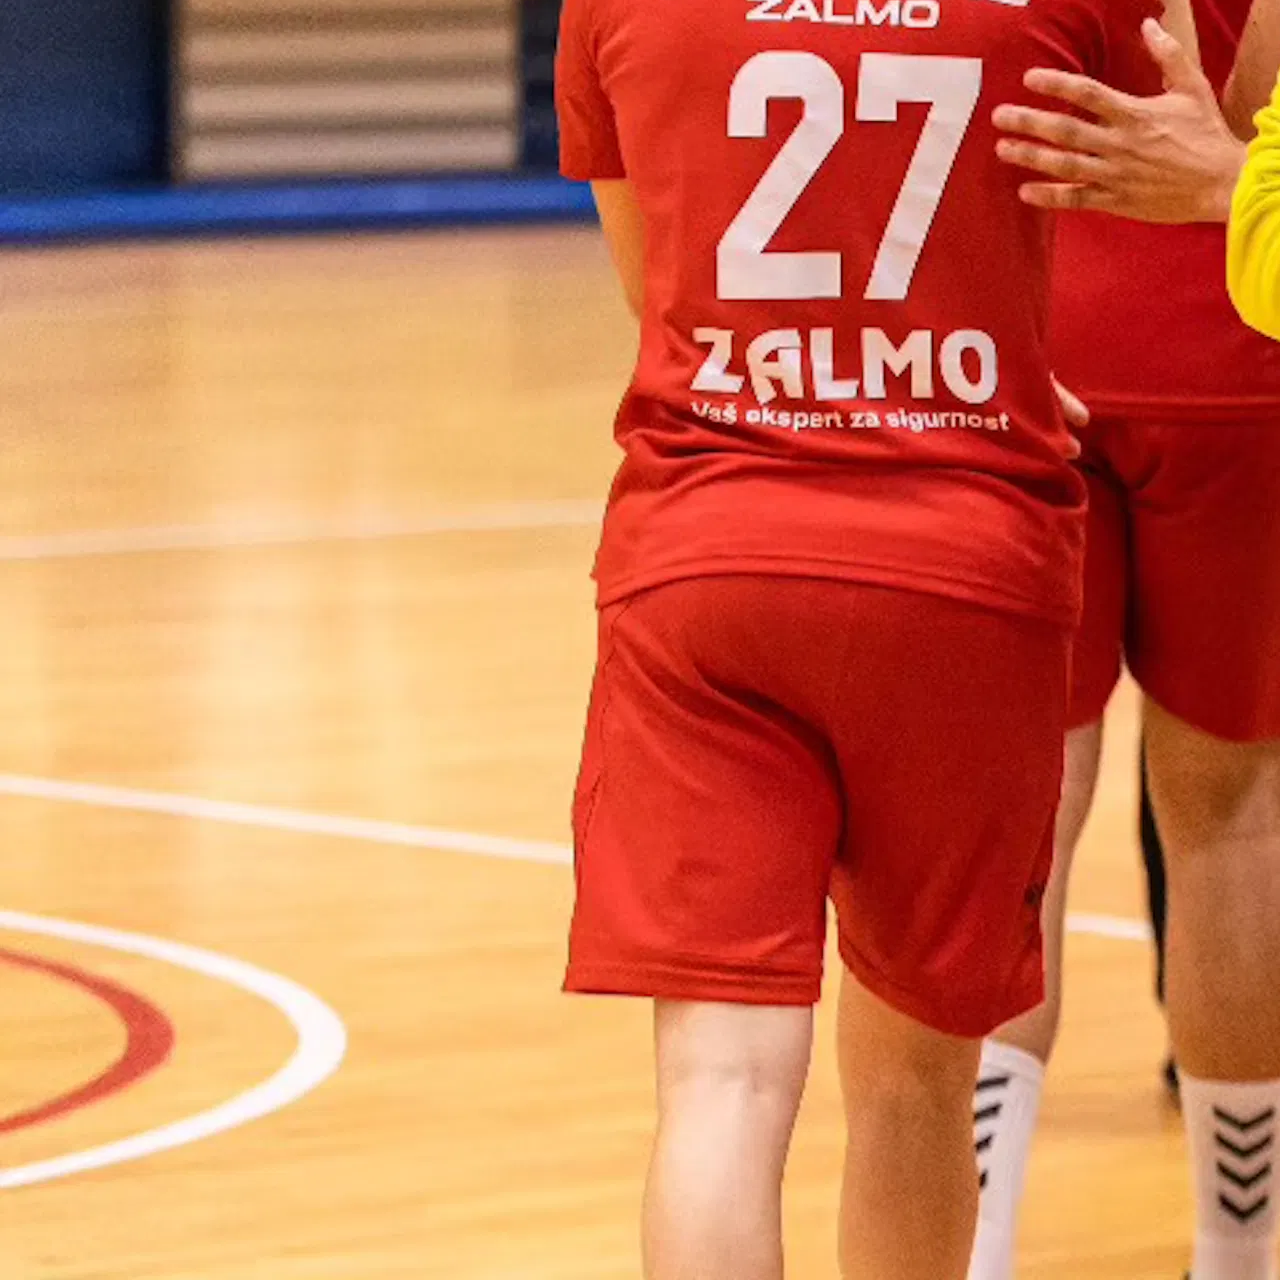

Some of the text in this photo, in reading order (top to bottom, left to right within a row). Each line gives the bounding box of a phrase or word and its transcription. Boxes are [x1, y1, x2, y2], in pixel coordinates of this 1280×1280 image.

[716, 50, 984, 300] 27
[691, 327, 998, 404] ZALMO
[690, 401, 1010, 433] Vaš ekspert za sigurnost
